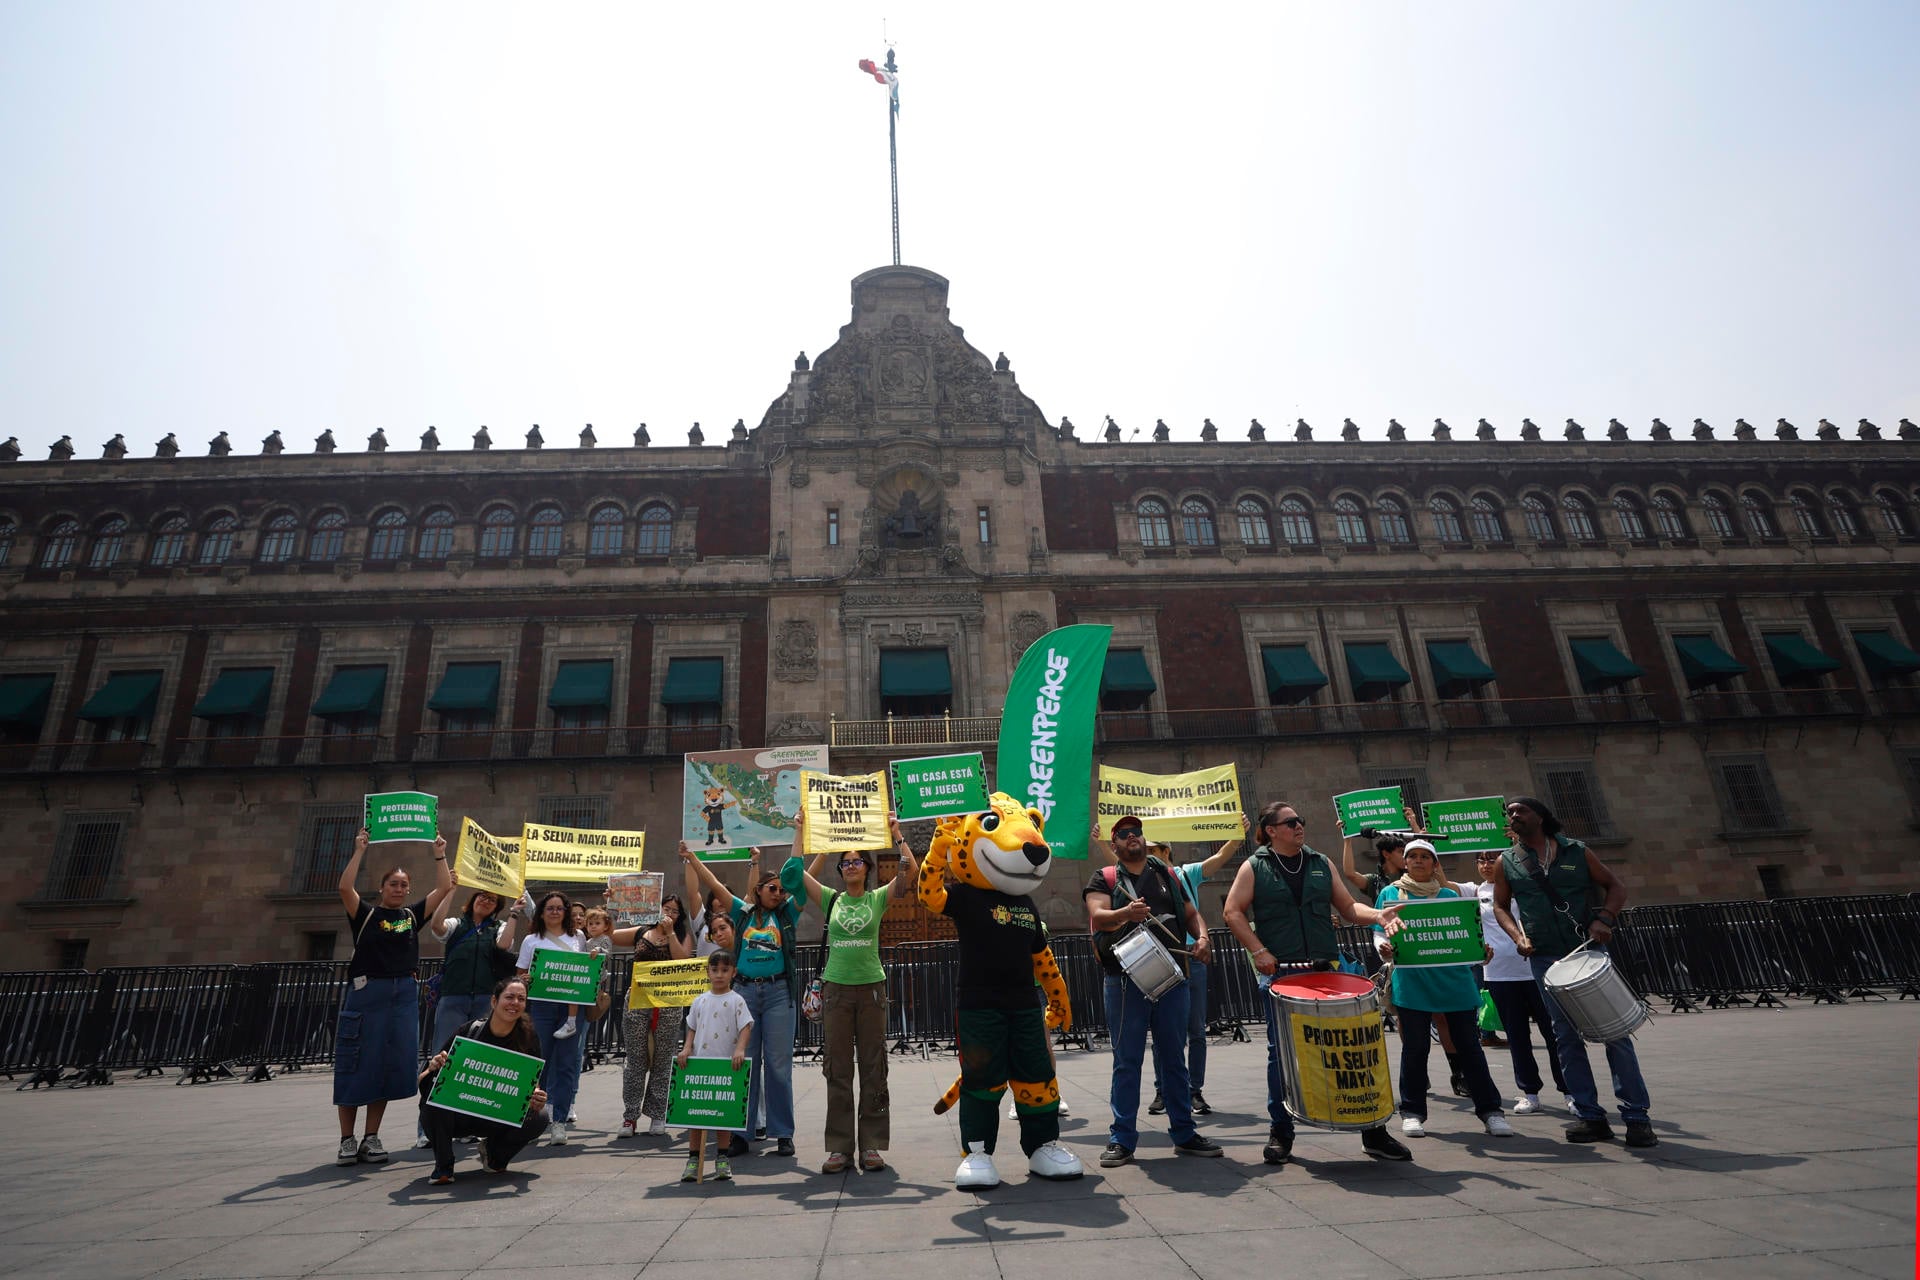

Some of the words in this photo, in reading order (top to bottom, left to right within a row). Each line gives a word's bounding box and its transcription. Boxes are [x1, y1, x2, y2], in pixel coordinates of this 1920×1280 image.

[1026, 648, 1069, 822] GREENPEACE
[907, 773, 920, 784] MI
[922, 770, 947, 782] CASA
[950, 766, 973, 779] ESTÁ
[919, 787, 932, 797] EN
[935, 783, 964, 795] JUEGO
[1099, 780, 1112, 793] LA
[1116, 782, 1153, 798] SELVA
[1157, 787, 1193, 799] MAYA
[1197, 778, 1235, 796] GRITA
[819, 794, 833, 809] LA
[836, 794, 869, 809] SELVA
[1348, 798, 1390, 810] PROTEJAMOS
[381, 804, 427, 813] PROTEJAMOS
[1098, 802, 1167, 817] SEMARNAT
[1358, 809, 1378, 817] SELVA
[1379, 807, 1397, 815] MAYA
[378, 815, 388, 823] LA
[390, 814, 412, 822] SELVA
[414, 814, 431, 823] MAYA
[829, 809, 862, 824] MAYA
[1439, 811, 1489, 822] PROTEJAMOS
[1191, 823, 1238, 831] GREENPEACE
[1438, 825, 1449, 834] LA
[1450, 823, 1473, 833] SELVA
[1475, 822, 1497, 831] MAYA
[468, 825, 520, 853] PROTEAMOS
[526, 828, 539, 841] LA
[542, 829, 574, 844] SELVA
[578, 833, 607, 846] MAYA
[610, 835, 641, 848] GRITA
[474, 842, 484, 855] LA
[525, 849, 583, 865] SEMARNAT
[479, 856, 502, 873] MAYA
[1404, 916, 1461, 929] PROTEJAMOS
[1403, 933, 1415, 942] LA
[1417, 931, 1444, 941] SELVA
[1446, 929, 1469, 940] MAYA
[545, 961, 589, 973] PROTEJAMOS
[650, 963, 703, 976] GREENPEACE
[540, 972, 549, 980] LA
[551, 973, 571, 983] SELVA
[572, 976, 591, 985] MAYA
[661, 979, 693, 988] protegemos
[1321, 1049, 1340, 1069] LA
[1342, 1048, 1380, 1070] SELVA
[463, 1057, 520, 1081] PROTEJAMOS
[454, 1071, 466, 1082] LA
[467, 1075, 494, 1090] SELVA
[495, 1082, 519, 1097] MAYA
[684, 1075, 732, 1086] PROTEJAMOS
[1336, 1070, 1376, 1090] MAYA
[680, 1089, 690, 1099] LA
[691, 1090, 713, 1101] SELVA
[715, 1091, 736, 1101] MAYA
